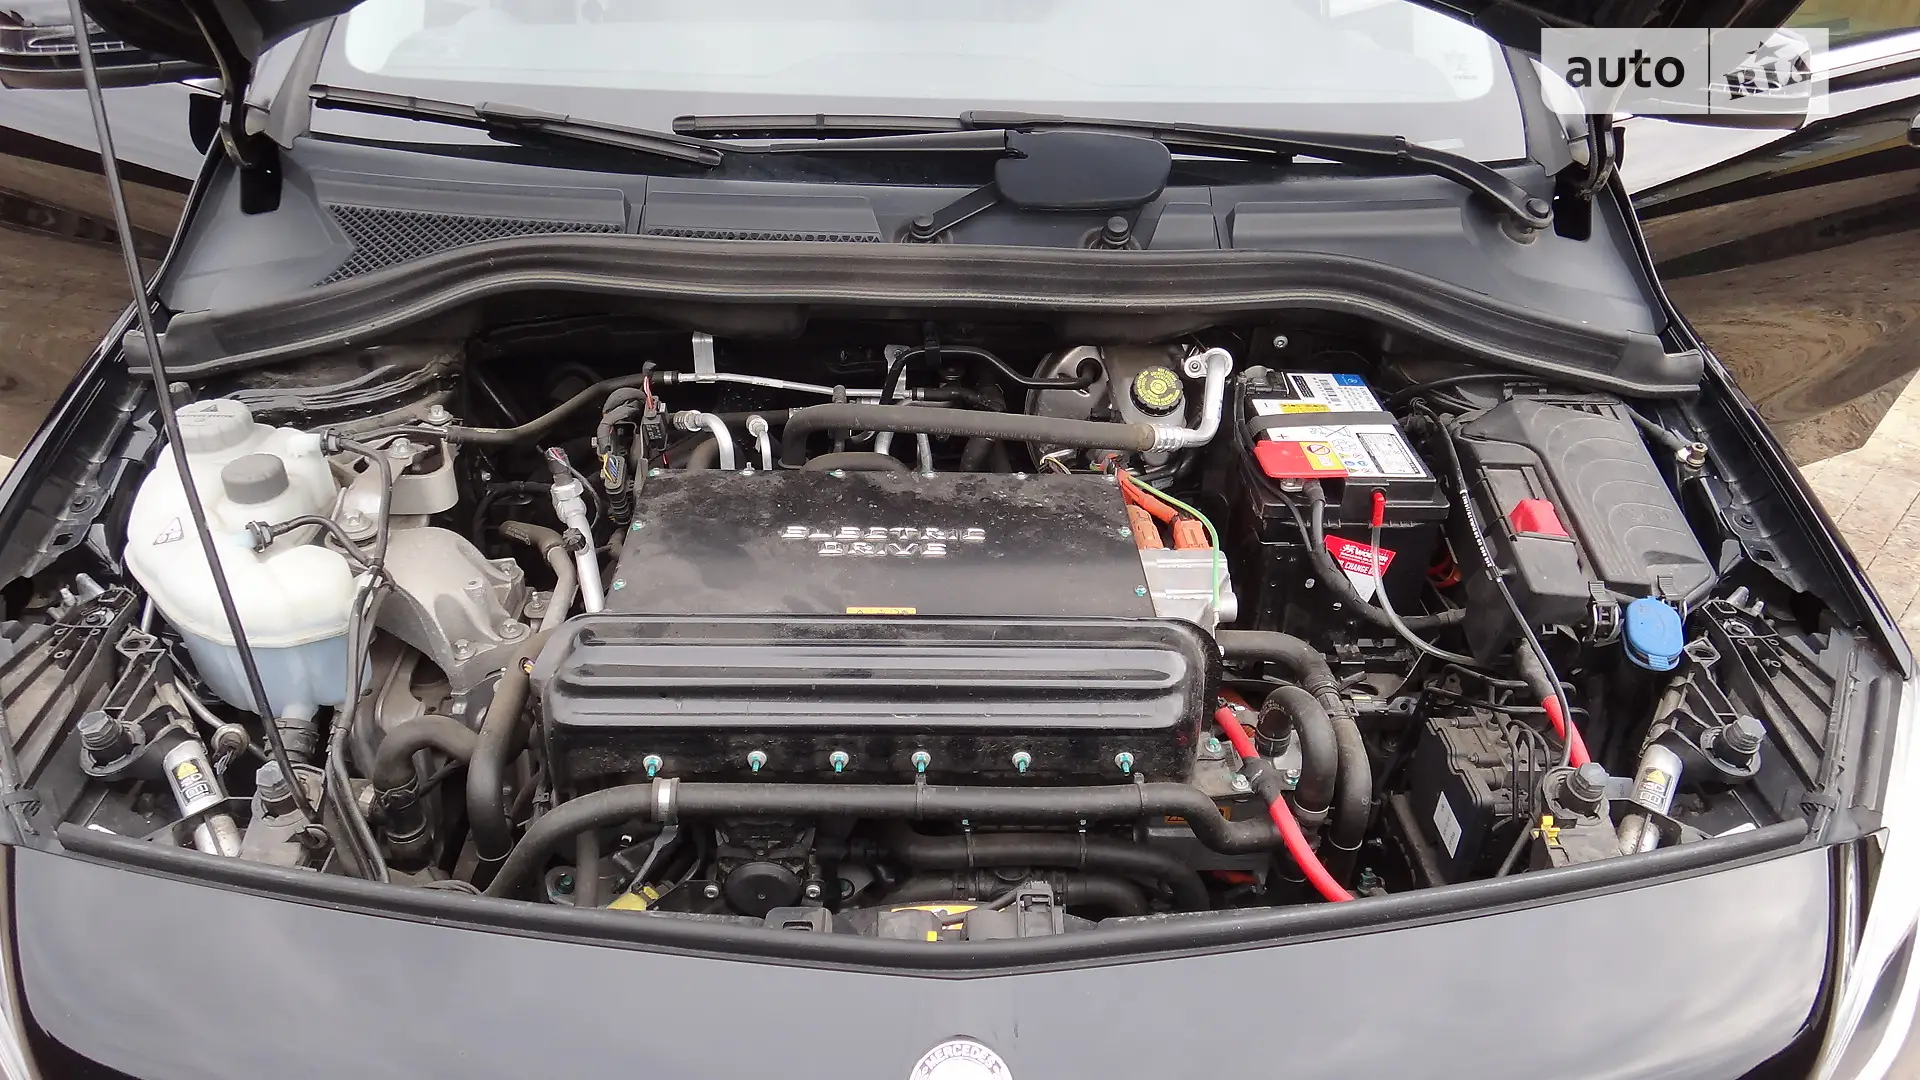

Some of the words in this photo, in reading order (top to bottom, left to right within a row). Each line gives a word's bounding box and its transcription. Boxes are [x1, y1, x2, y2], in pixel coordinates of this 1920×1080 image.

[780, 525, 986, 541] ELECTRIC
[818, 541, 948, 557] DRIVE
[1344, 561, 1370, 574] CHANGE
[924, 1043, 996, 1070] MERCEDES
